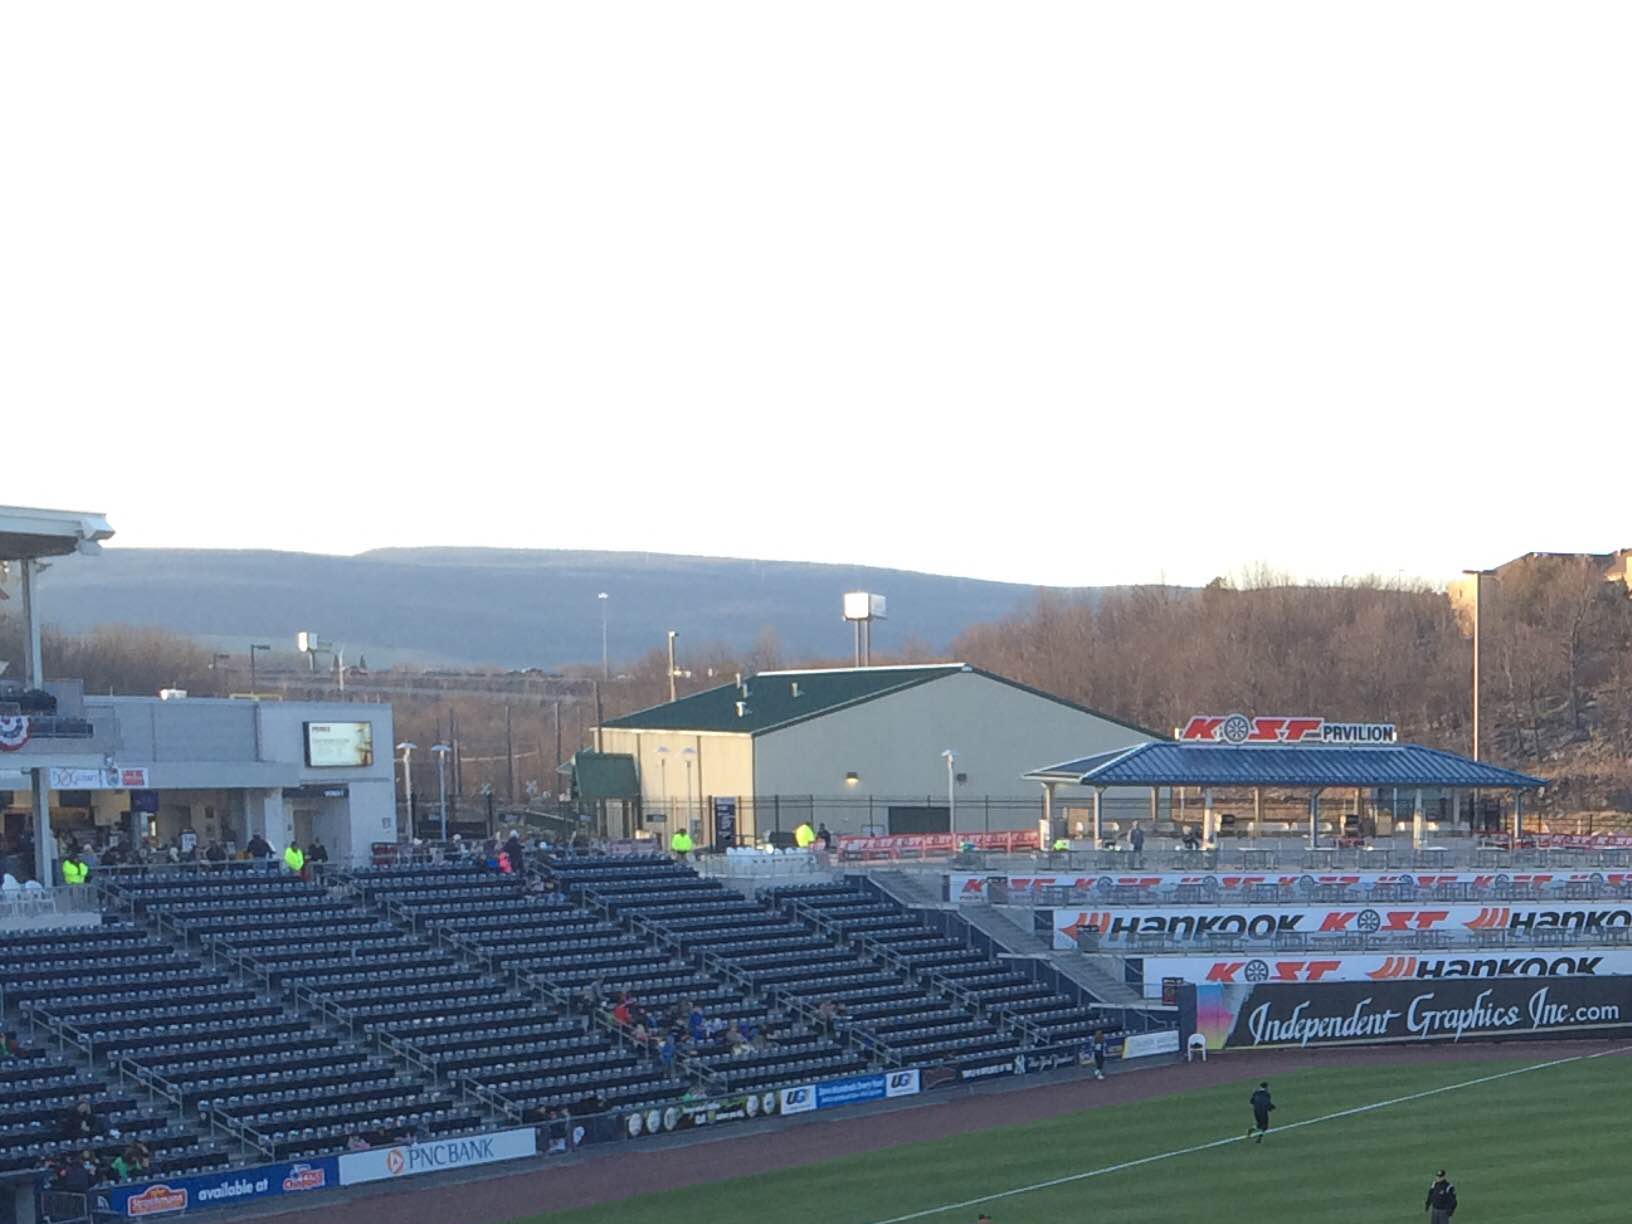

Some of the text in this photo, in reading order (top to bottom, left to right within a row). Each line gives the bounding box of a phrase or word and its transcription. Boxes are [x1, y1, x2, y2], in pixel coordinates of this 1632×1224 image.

[1183, 714, 1395, 744] KOST PAVILION
[1249, 997, 1401, 1047] Independent
[1406, 988, 1521, 1043] Graphics
[408, 1138, 495, 1169] PNC BANK
[198, 1179, 254, 1201] available
[256, 1178, 268, 1192] at
